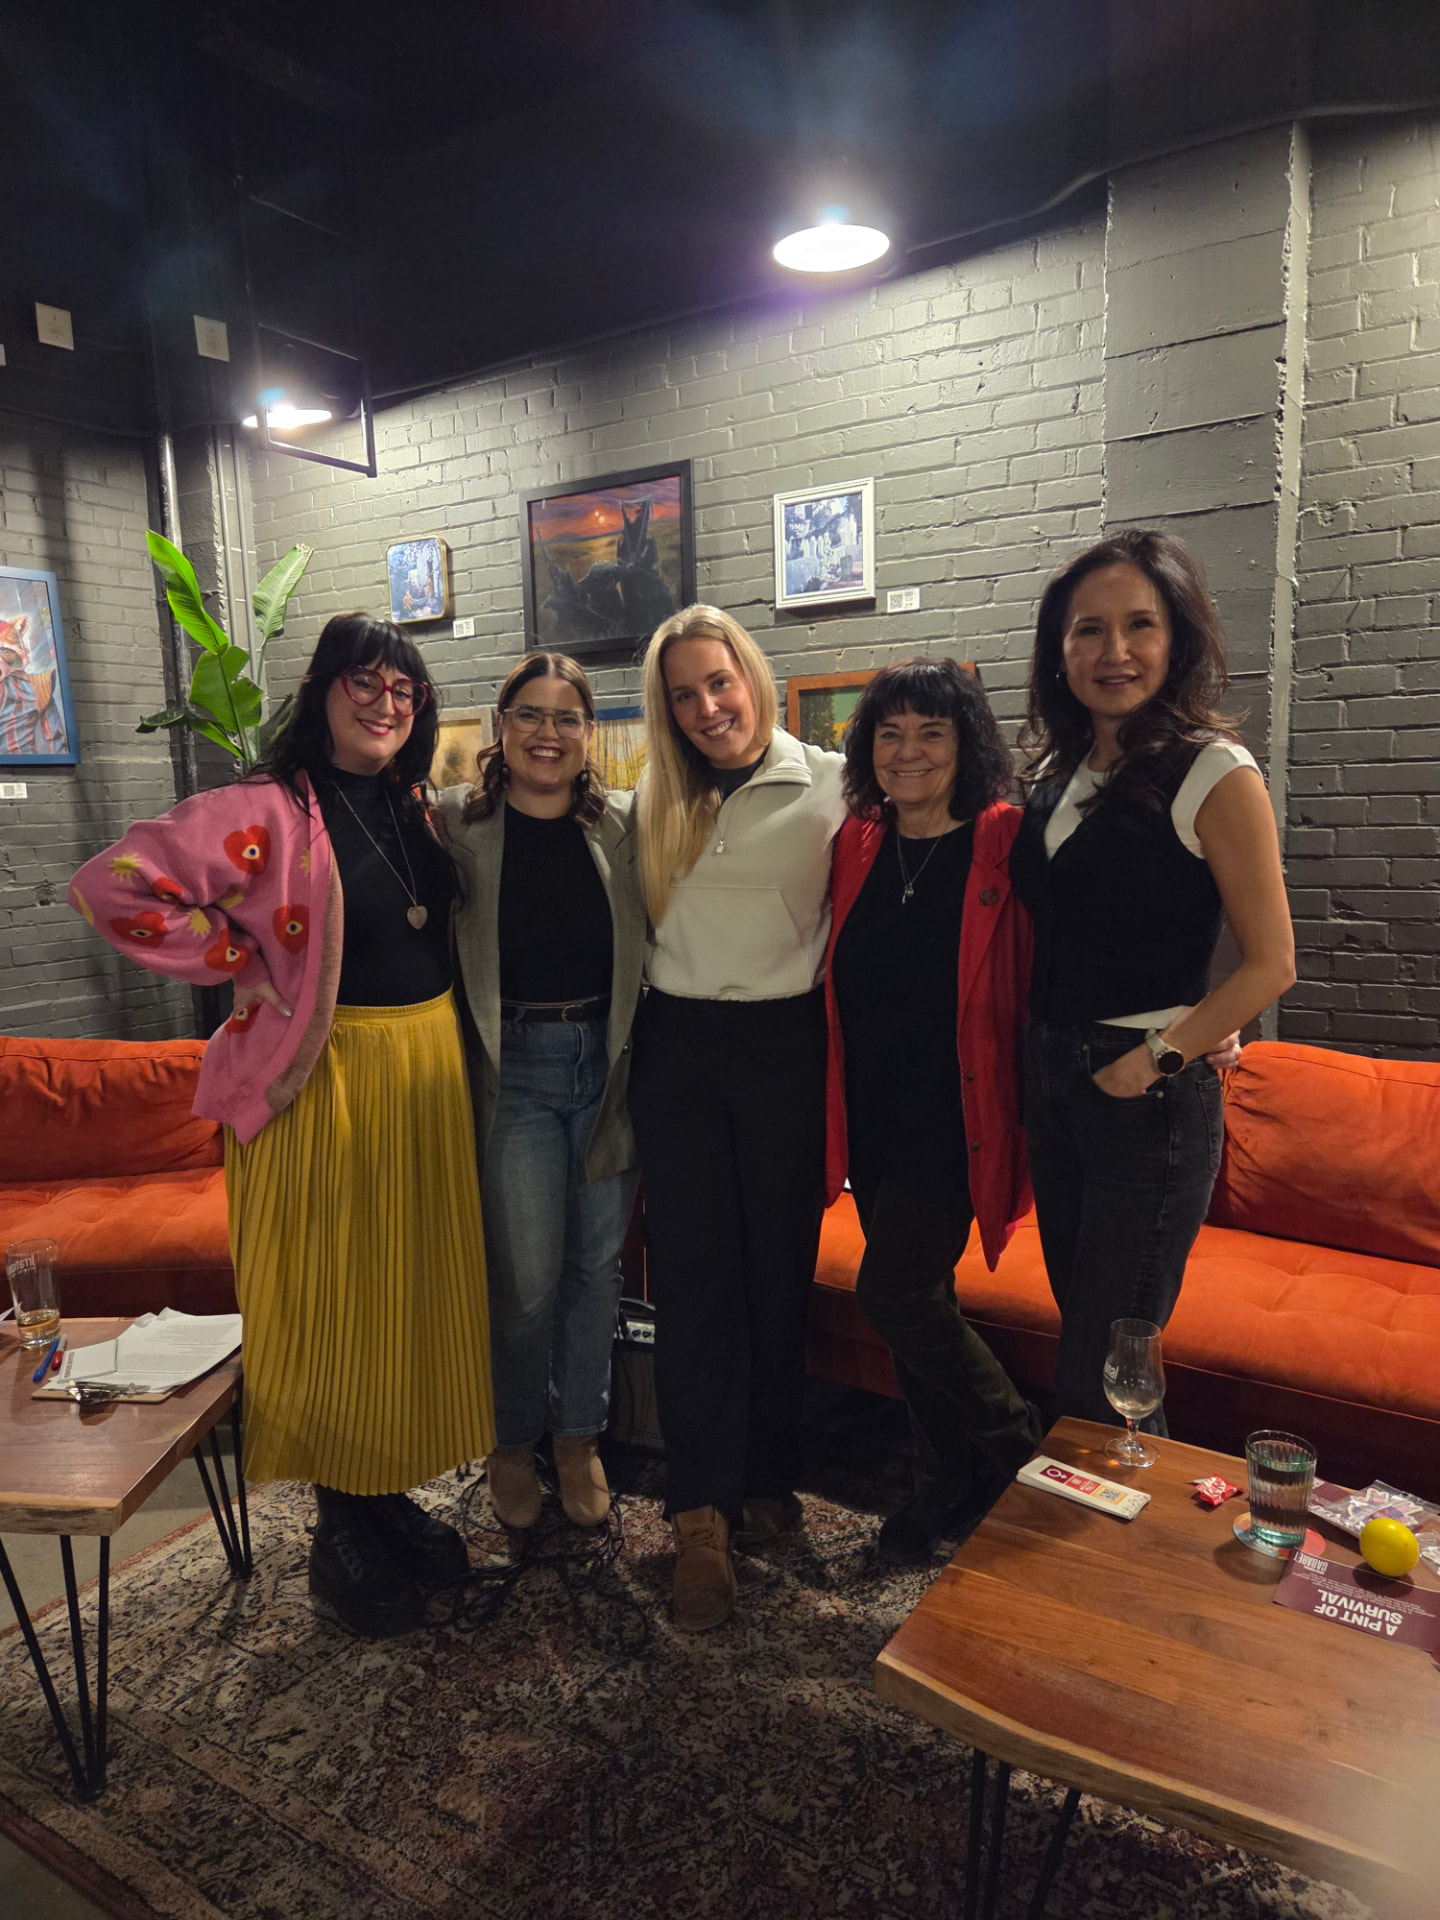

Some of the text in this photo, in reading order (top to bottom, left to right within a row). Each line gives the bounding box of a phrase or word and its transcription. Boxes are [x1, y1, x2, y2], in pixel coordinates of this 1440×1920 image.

[1313, 1603, 1399, 1637] A PINT OF
[1317, 1588, 1404, 1625] SURVIVAL
